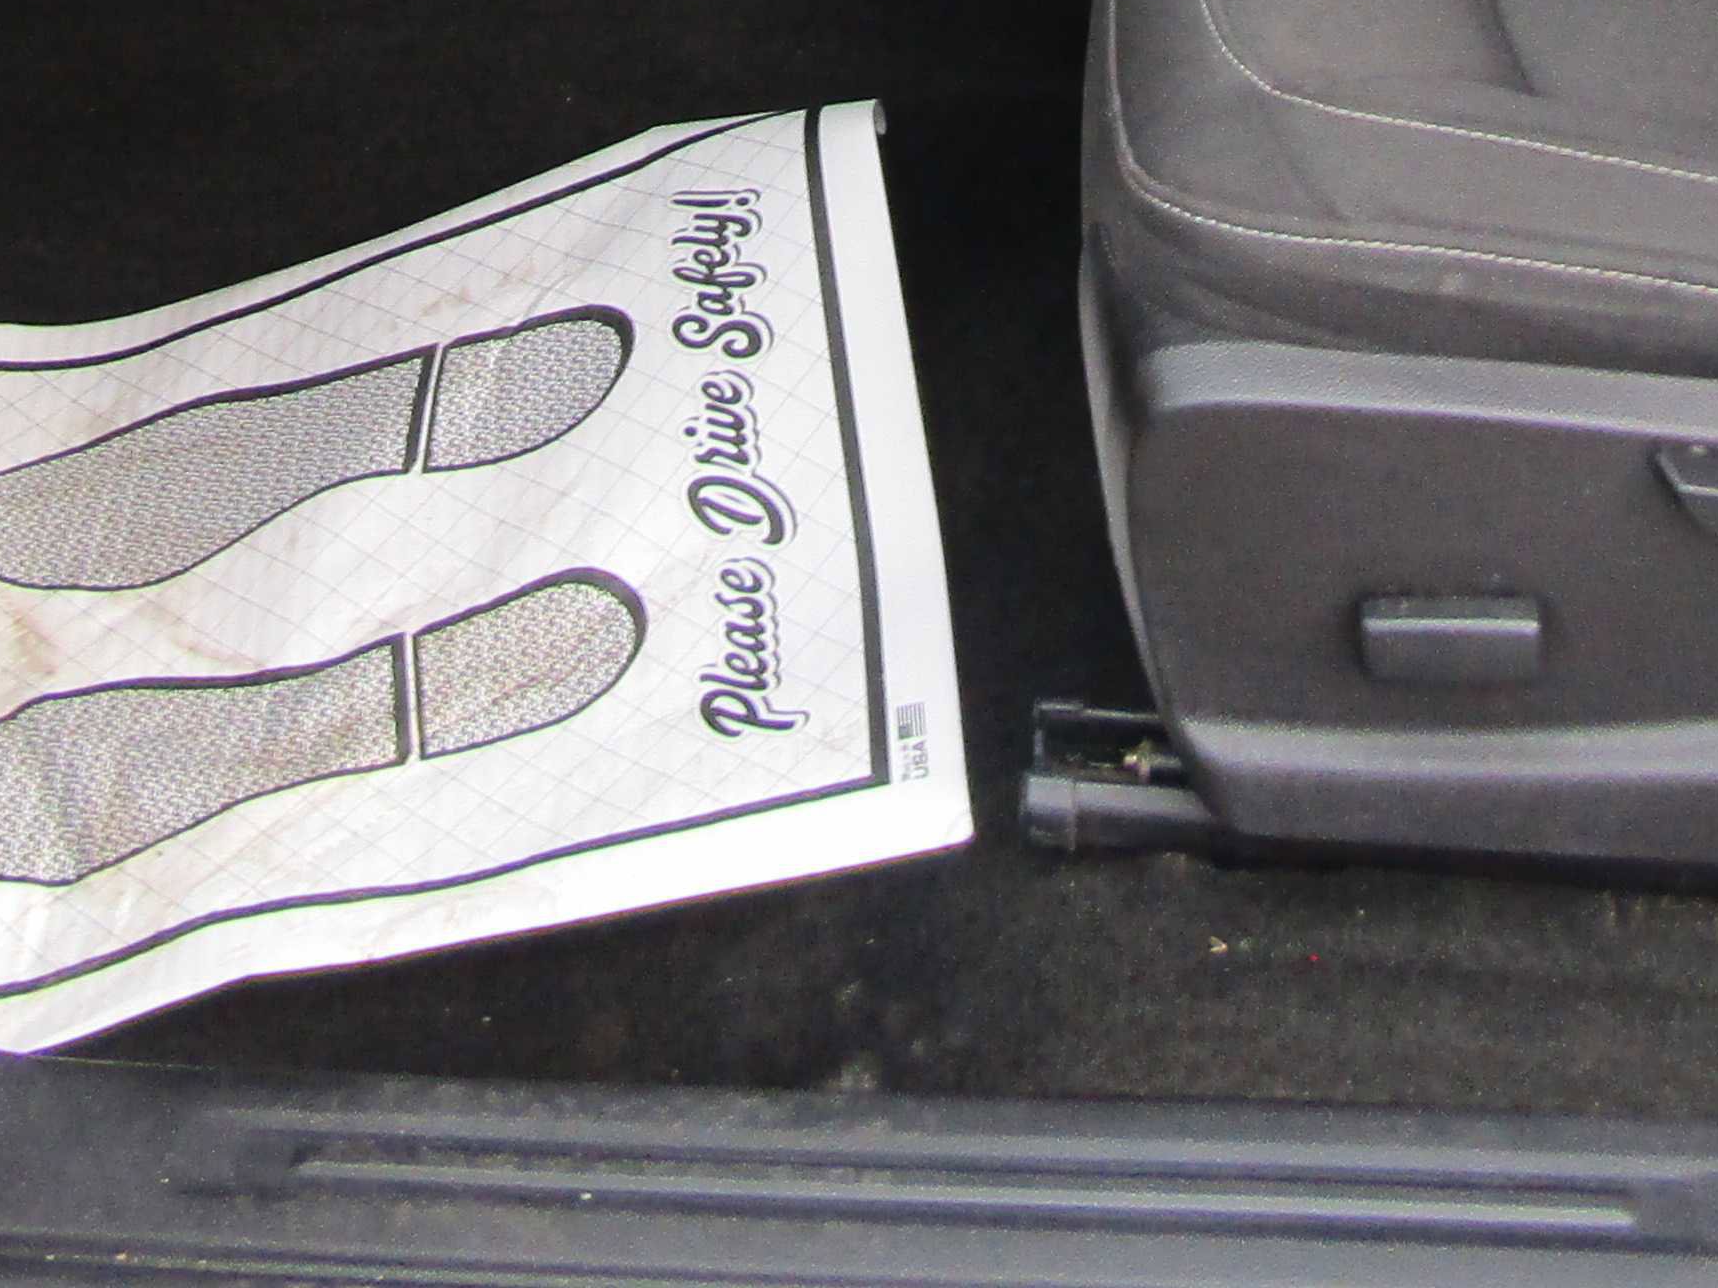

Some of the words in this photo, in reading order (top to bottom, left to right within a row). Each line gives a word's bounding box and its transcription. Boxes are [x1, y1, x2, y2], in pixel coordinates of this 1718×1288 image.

[670, 193, 763, 360] Safely!
[685, 378, 785, 547] Drive
[699, 566, 798, 739] Please
[910, 739, 929, 779] USA
